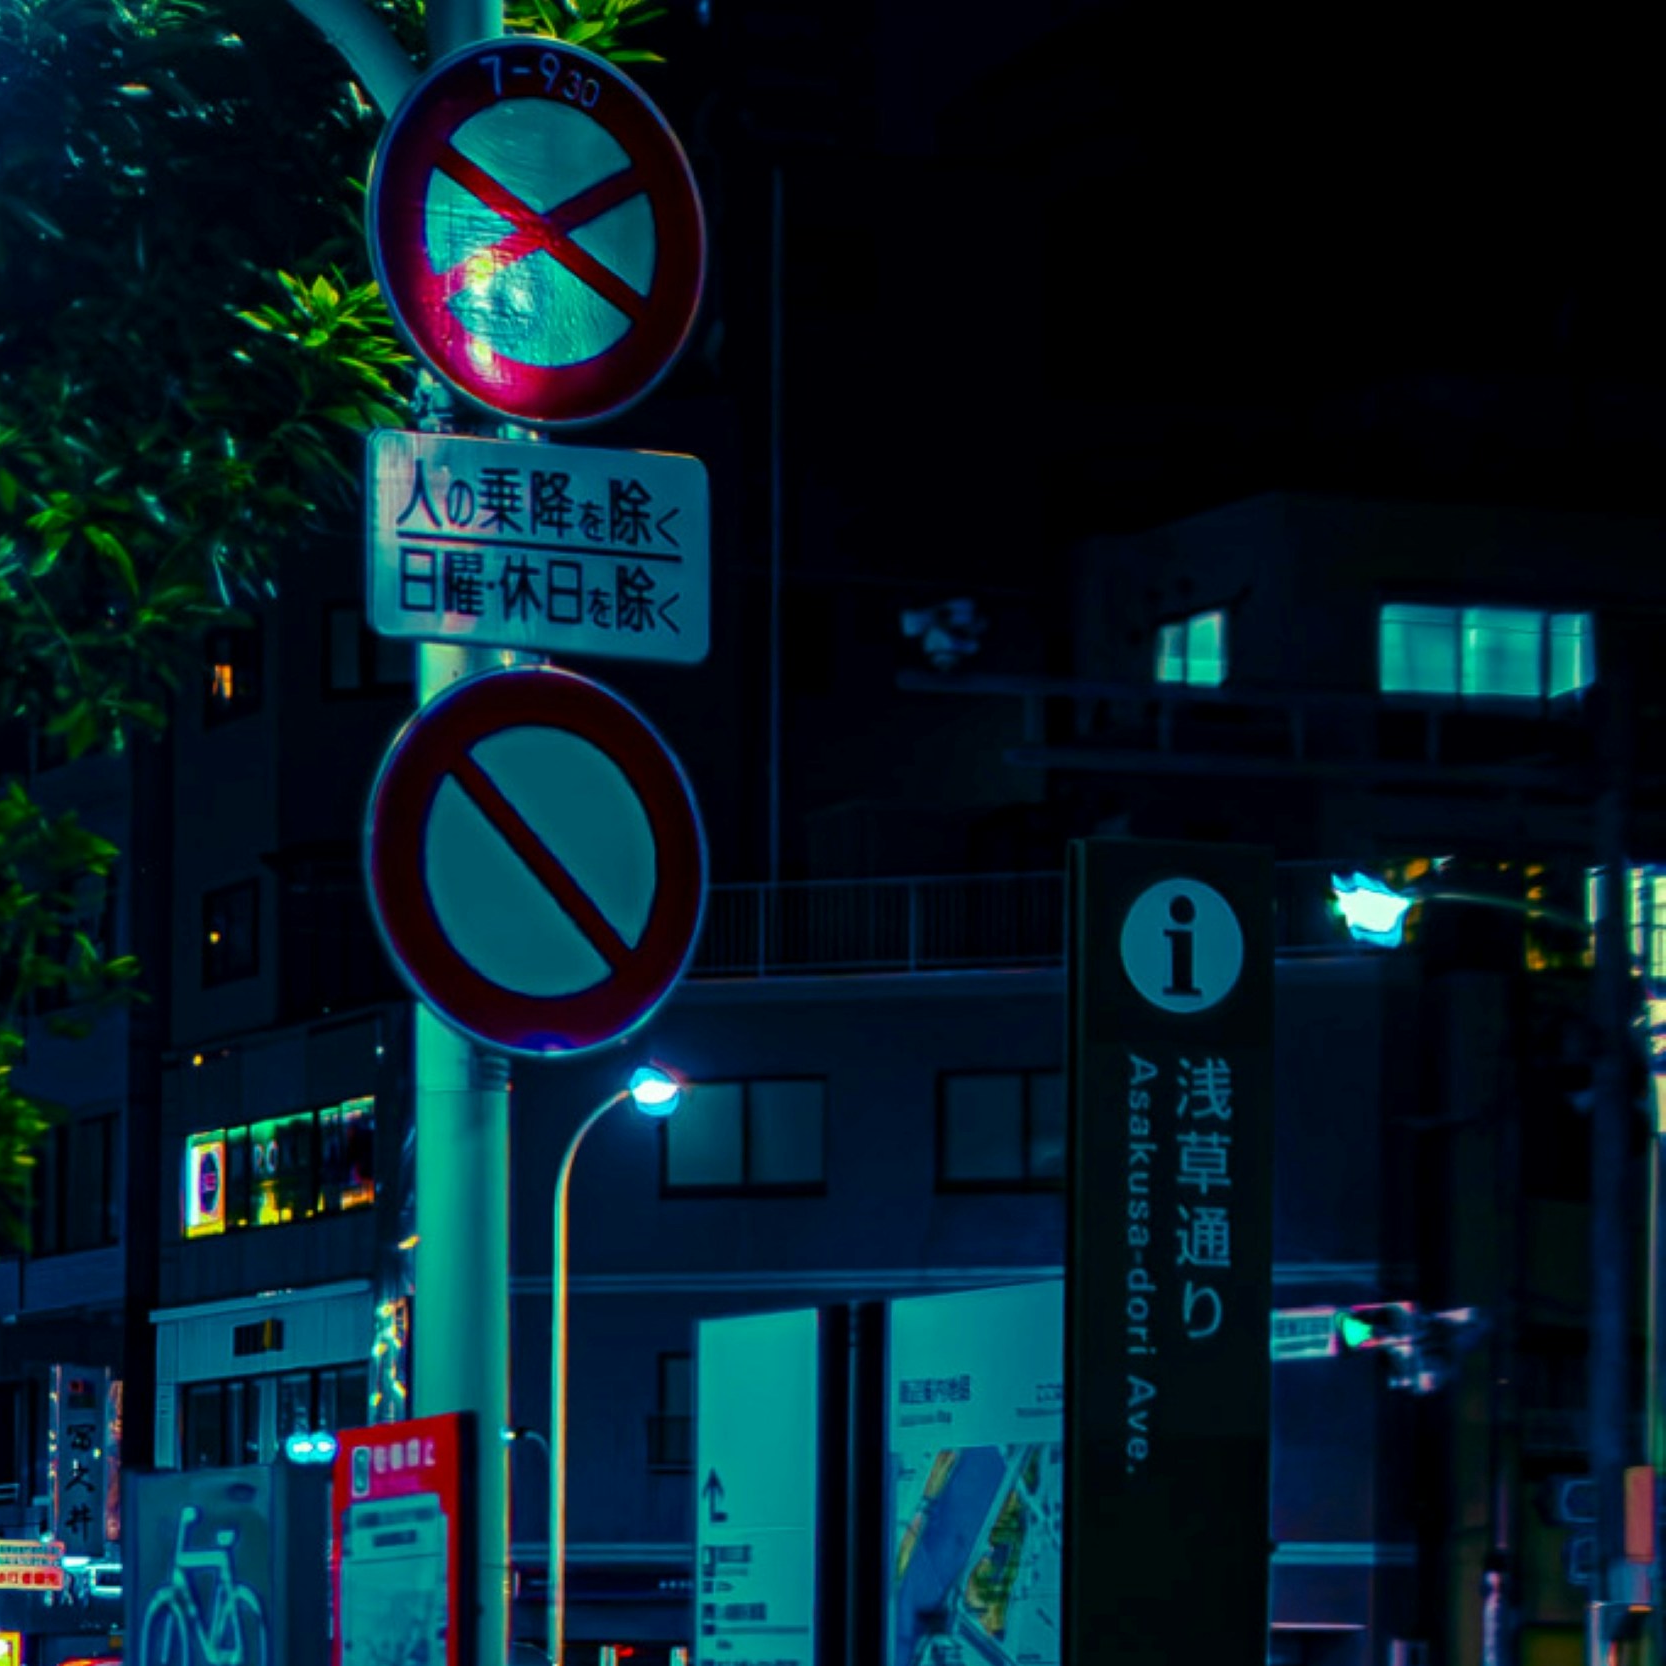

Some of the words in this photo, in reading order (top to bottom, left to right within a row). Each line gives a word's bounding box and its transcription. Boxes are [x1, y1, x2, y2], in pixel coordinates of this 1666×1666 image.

[396, 458, 682, 548] 人の乗降を除く
[1126, 1052, 1159, 1356] Asakusa-dori
[1174, 1055, 1234, 1341] 浅草通り
[1125, 1373, 1158, 1476] Ave.
